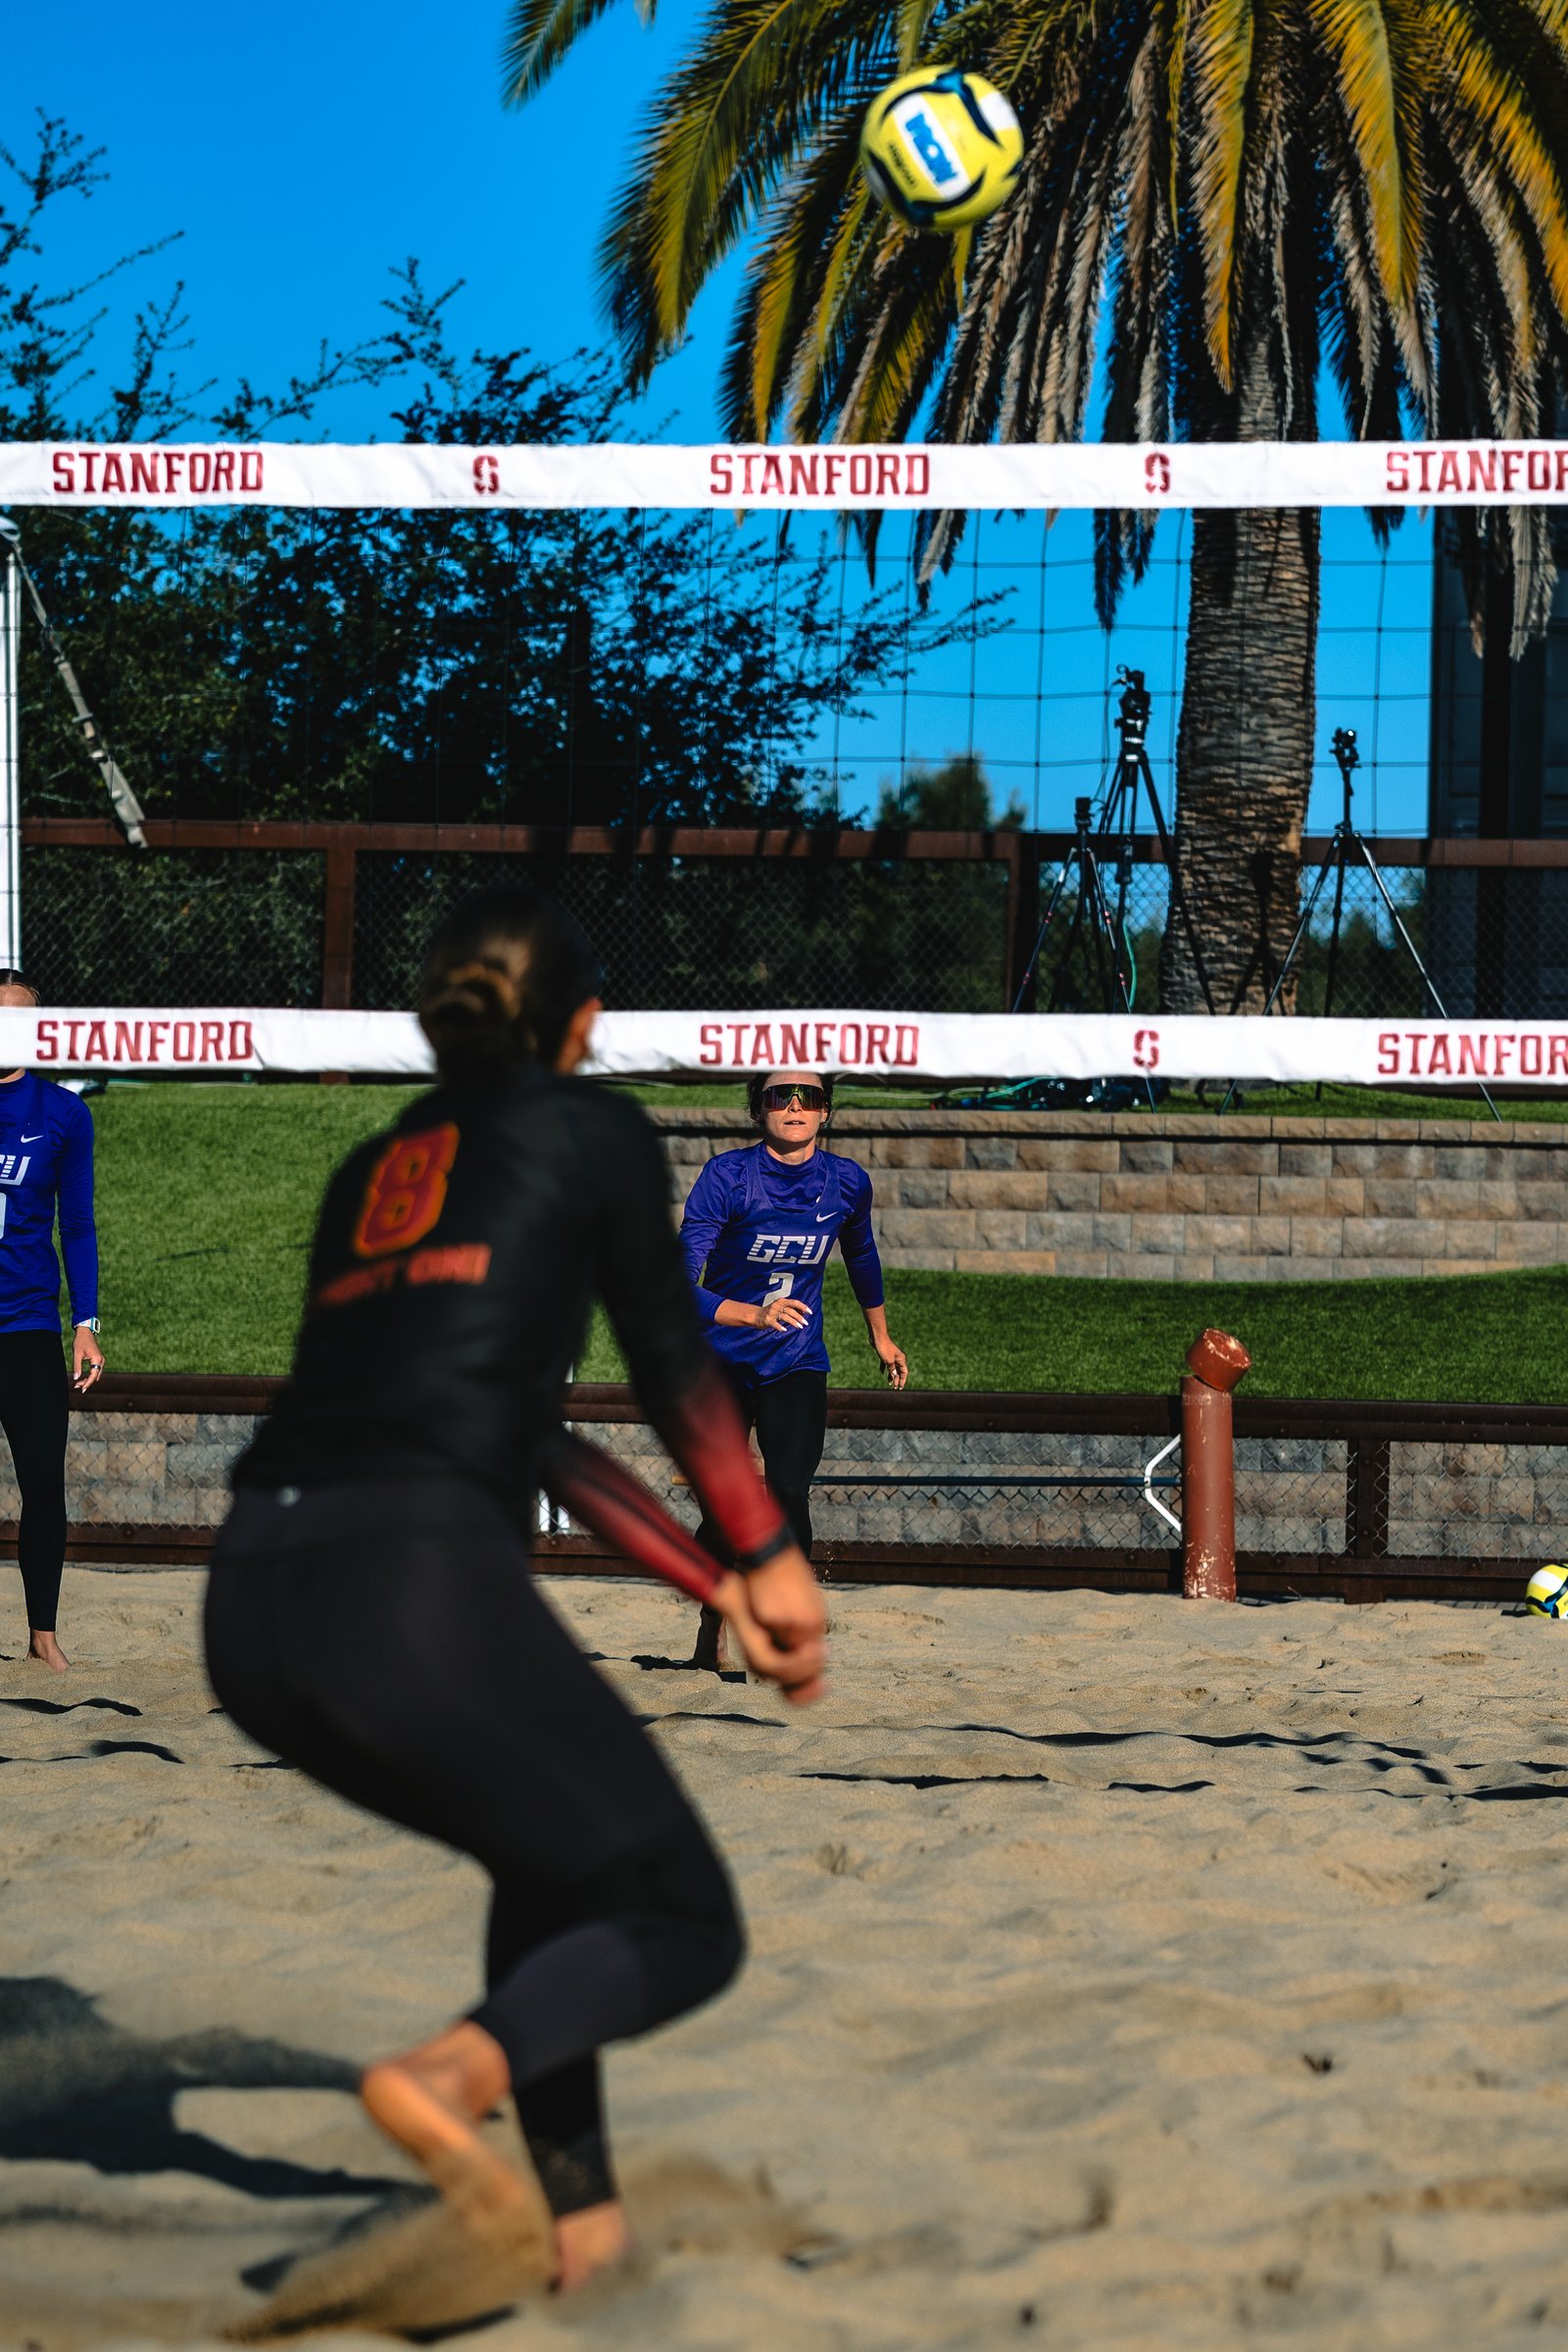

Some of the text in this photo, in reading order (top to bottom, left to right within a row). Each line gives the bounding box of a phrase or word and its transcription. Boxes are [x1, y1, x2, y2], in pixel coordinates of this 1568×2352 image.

[52, 451, 264, 494] STANFORD
[710, 453, 930, 496] STANFORD
[36, 1020, 255, 1062] STANFORD
[700, 1022, 919, 1066] STANFORD
[354, 1122, 460, 1258] 8
[747, 1233, 830, 1265] GCU
